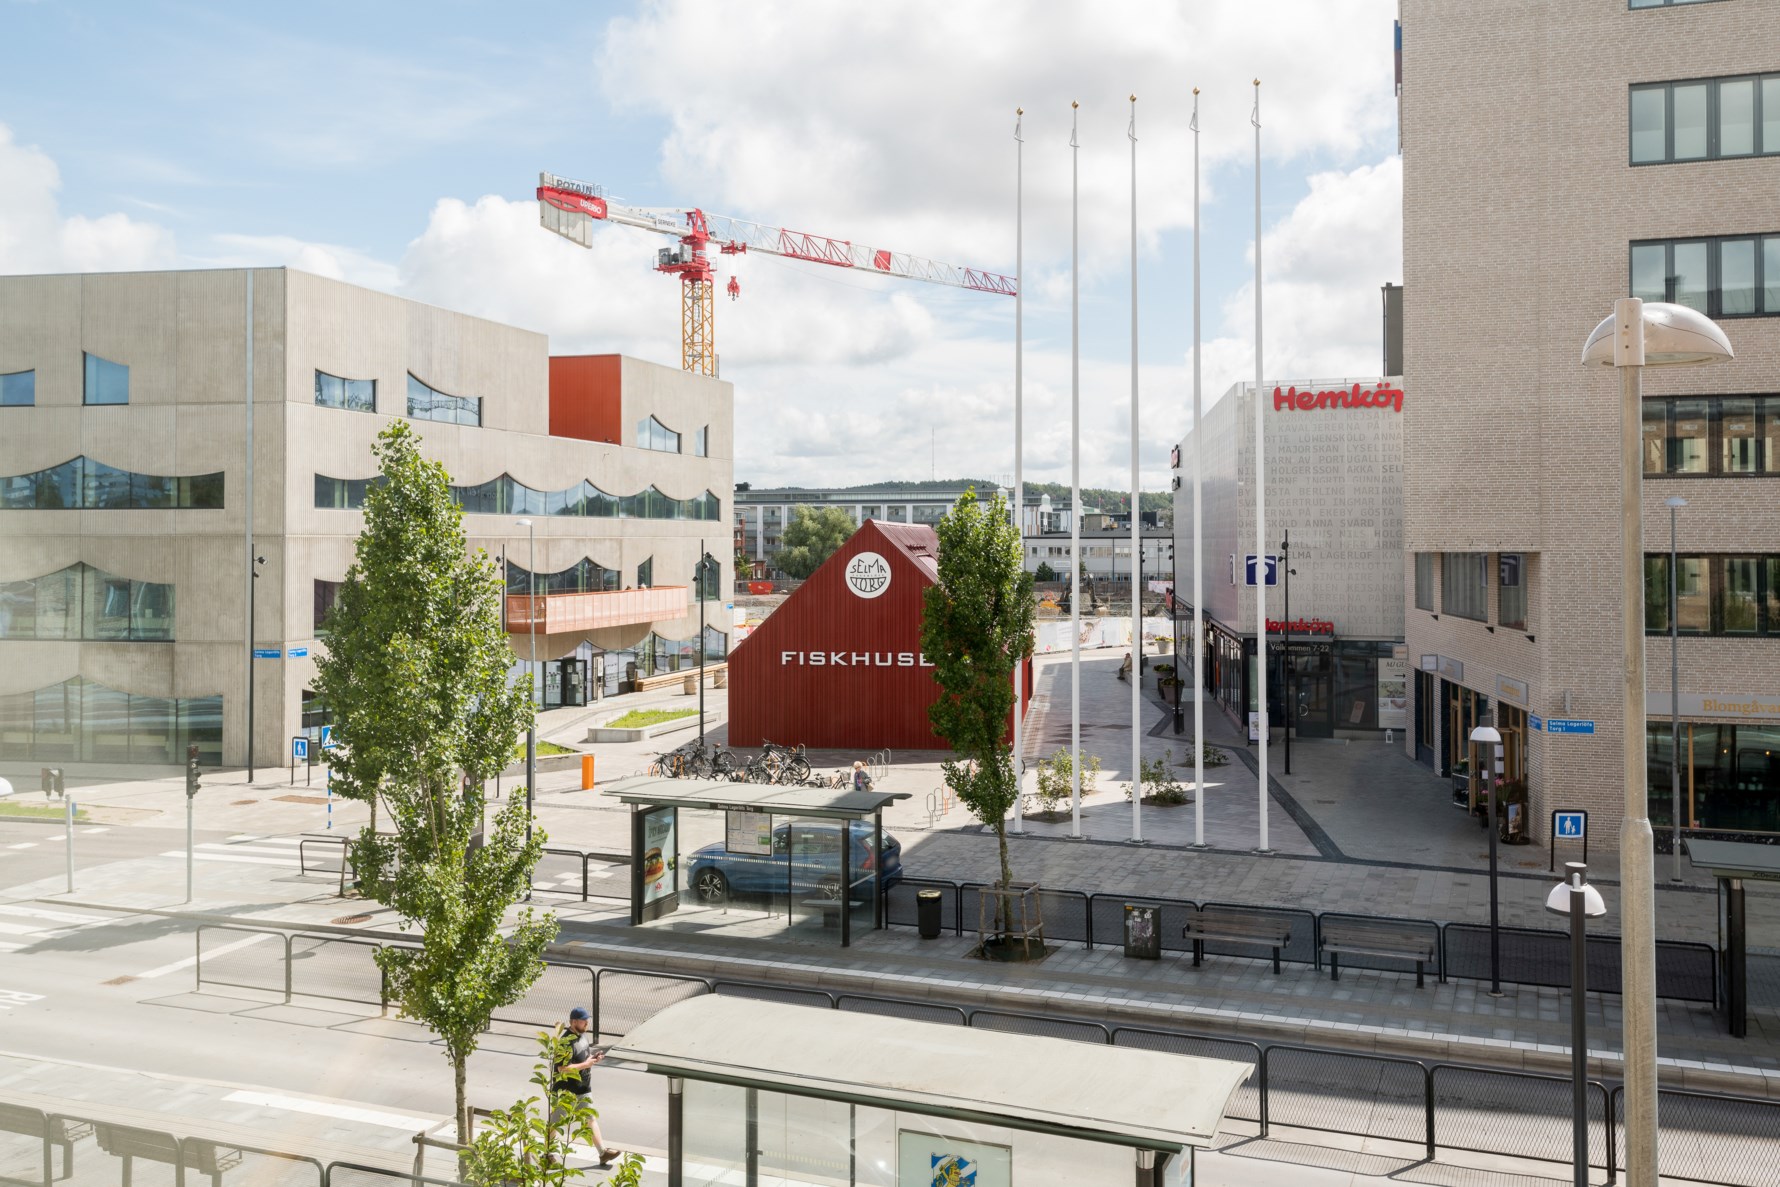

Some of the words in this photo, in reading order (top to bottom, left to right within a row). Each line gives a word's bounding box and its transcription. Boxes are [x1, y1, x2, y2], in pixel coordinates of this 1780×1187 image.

[556, 179, 593, 195] POTAIN
[580, 199, 602, 214] UPERIO
[1373, 432, 1402, 441] ANNA
[1278, 444, 1339, 454] MAJORSKAN
[1346, 443, 1402, 453] LYSELIUS
[1244, 455, 1292, 465] KESARN
[1298, 455, 1311, 464] AV
[1319, 453, 1402, 464] PORTUGALLIEN
[1271, 464, 1340, 475] HOLGERSSON
[1346, 464, 1374, 474] AKKA
[1264, 485, 1291, 497] ÖSTA
[1299, 486, 1346, 497] BERLING
[1278, 497, 1326, 508] GERTRUD
[1333, 496, 1375, 507] INGMAR
[1319, 508, 1354, 518] EKEBY
[1305, 518, 1334, 528] ANNA
[850, 558, 887, 574] SELMA
[850, 577, 887, 593] TORG
[1270, 643, 1311, 652] Välkmmen
[781, 651, 936, 667] FISKHUSE
